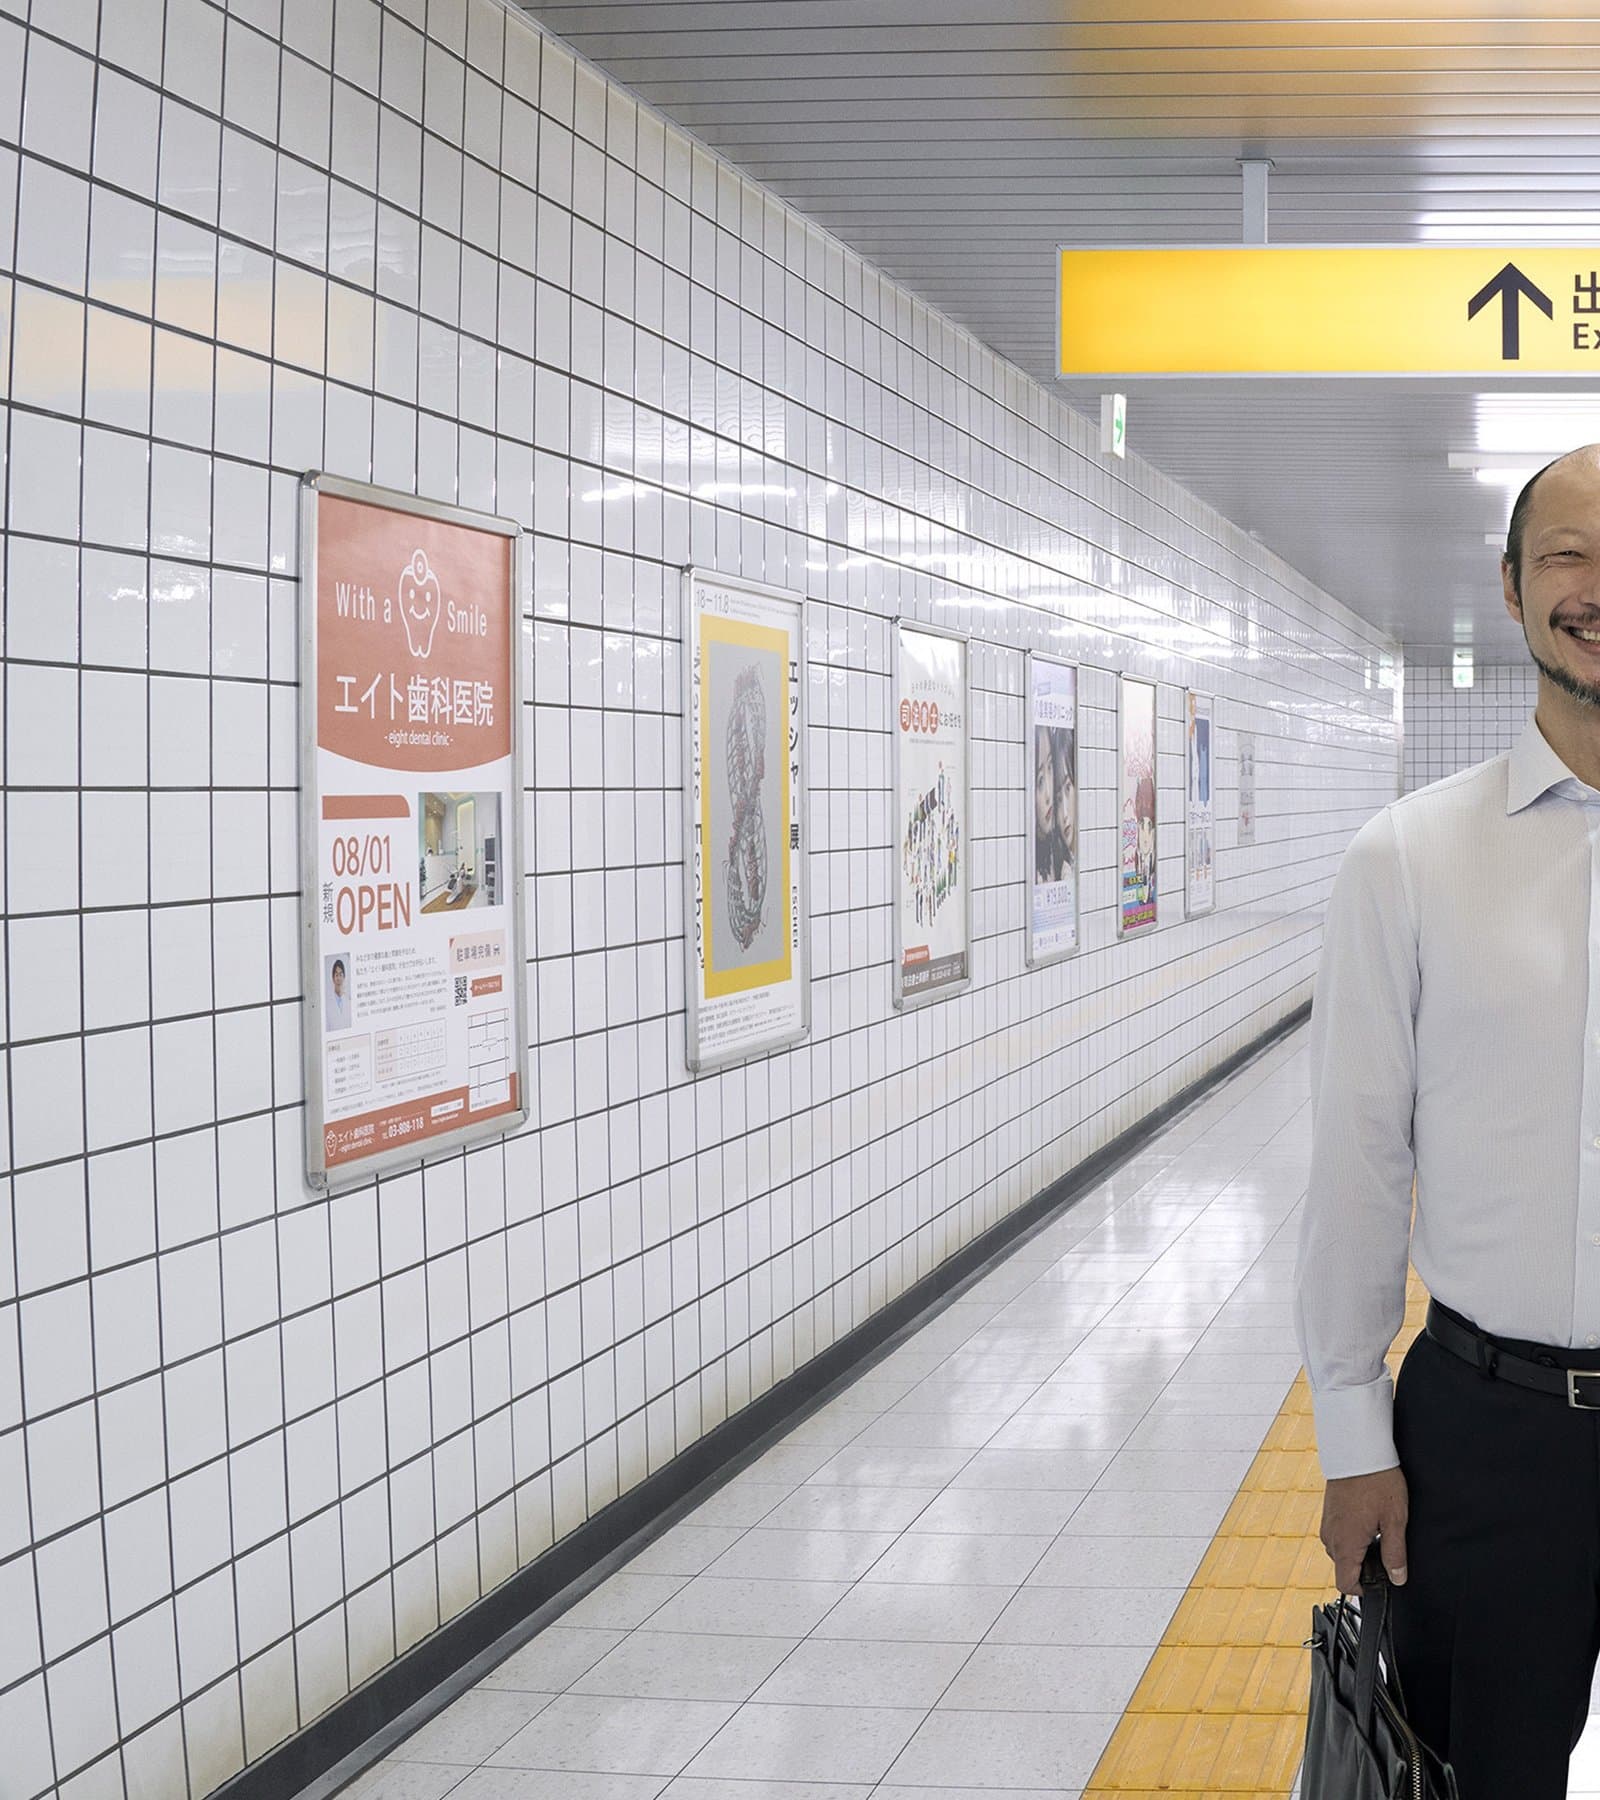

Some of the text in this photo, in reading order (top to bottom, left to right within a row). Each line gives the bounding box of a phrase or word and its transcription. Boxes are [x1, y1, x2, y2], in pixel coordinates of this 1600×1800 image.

[335, 582, 488, 637] With a Smile
[334, 671, 495, 727] エイト歯科医院
[408, 729, 431, 745] dental
[788, 660, 800, 851] エッシャー展
[332, 834, 391, 878] 08/01
[336, 882, 411, 935] OPEN
